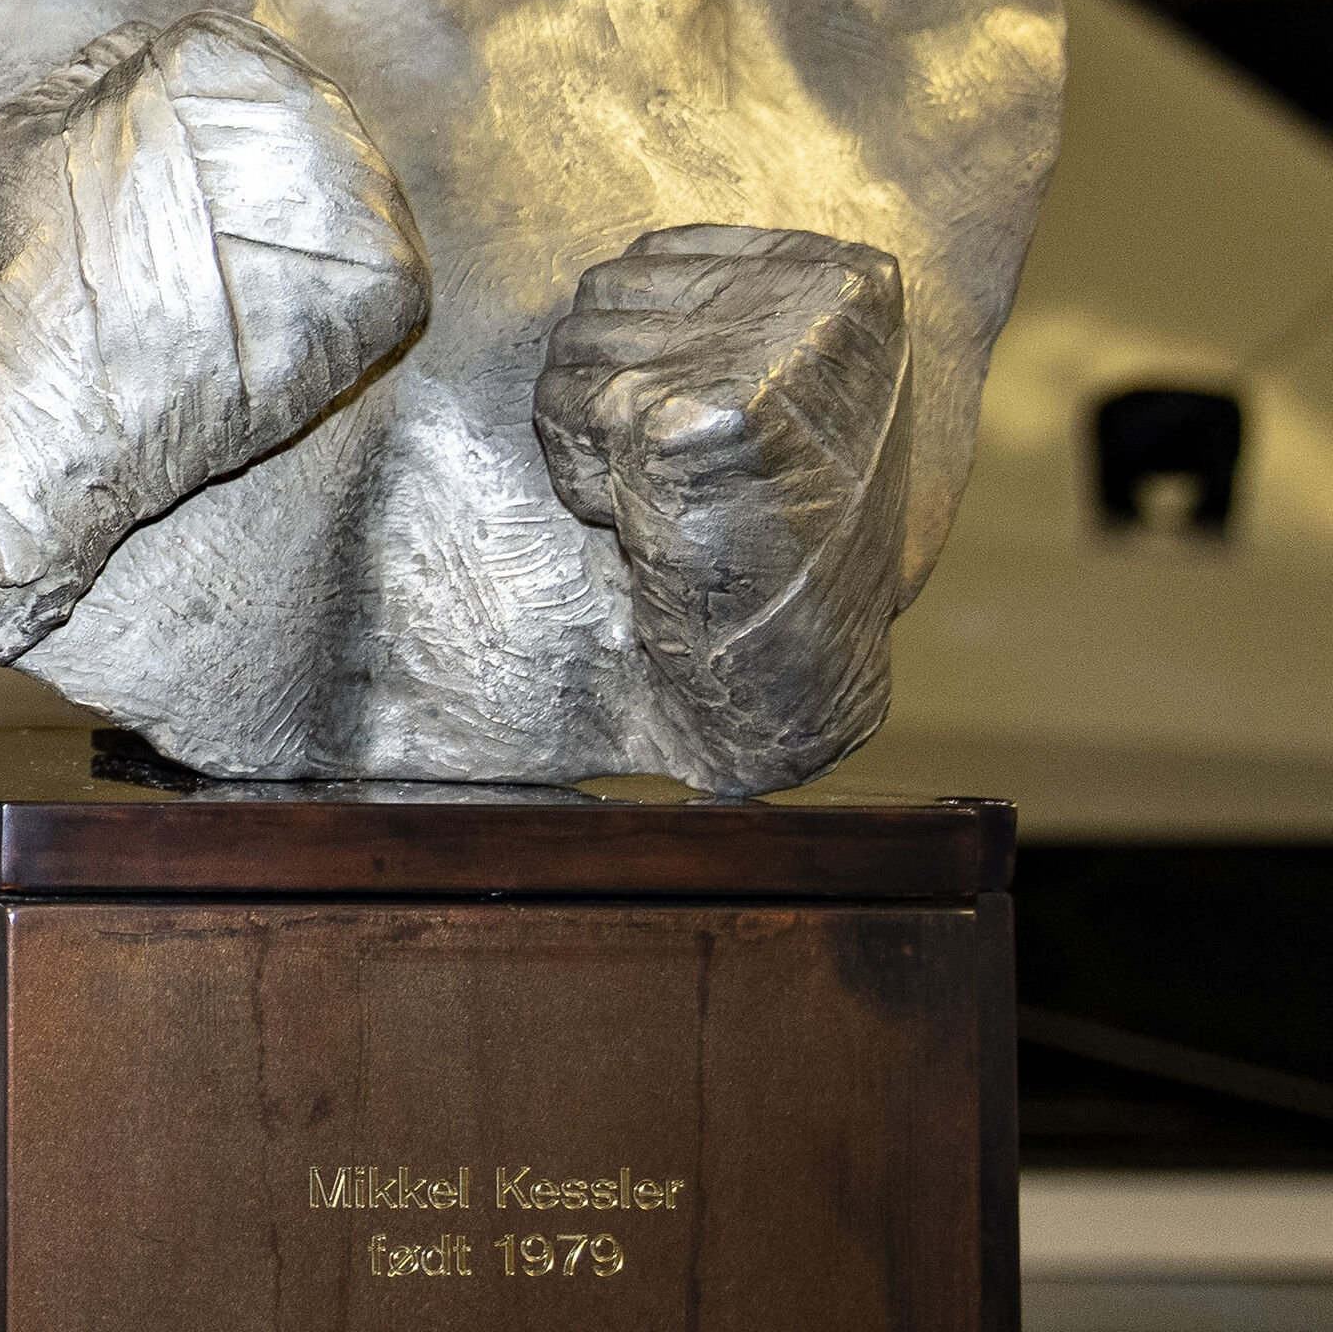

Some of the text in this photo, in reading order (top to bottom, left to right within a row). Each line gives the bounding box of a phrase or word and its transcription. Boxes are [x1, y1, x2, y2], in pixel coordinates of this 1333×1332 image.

[308, 1166, 685, 1210] Mikkel Kessler
[367, 1233, 624, 1277] født 1979
